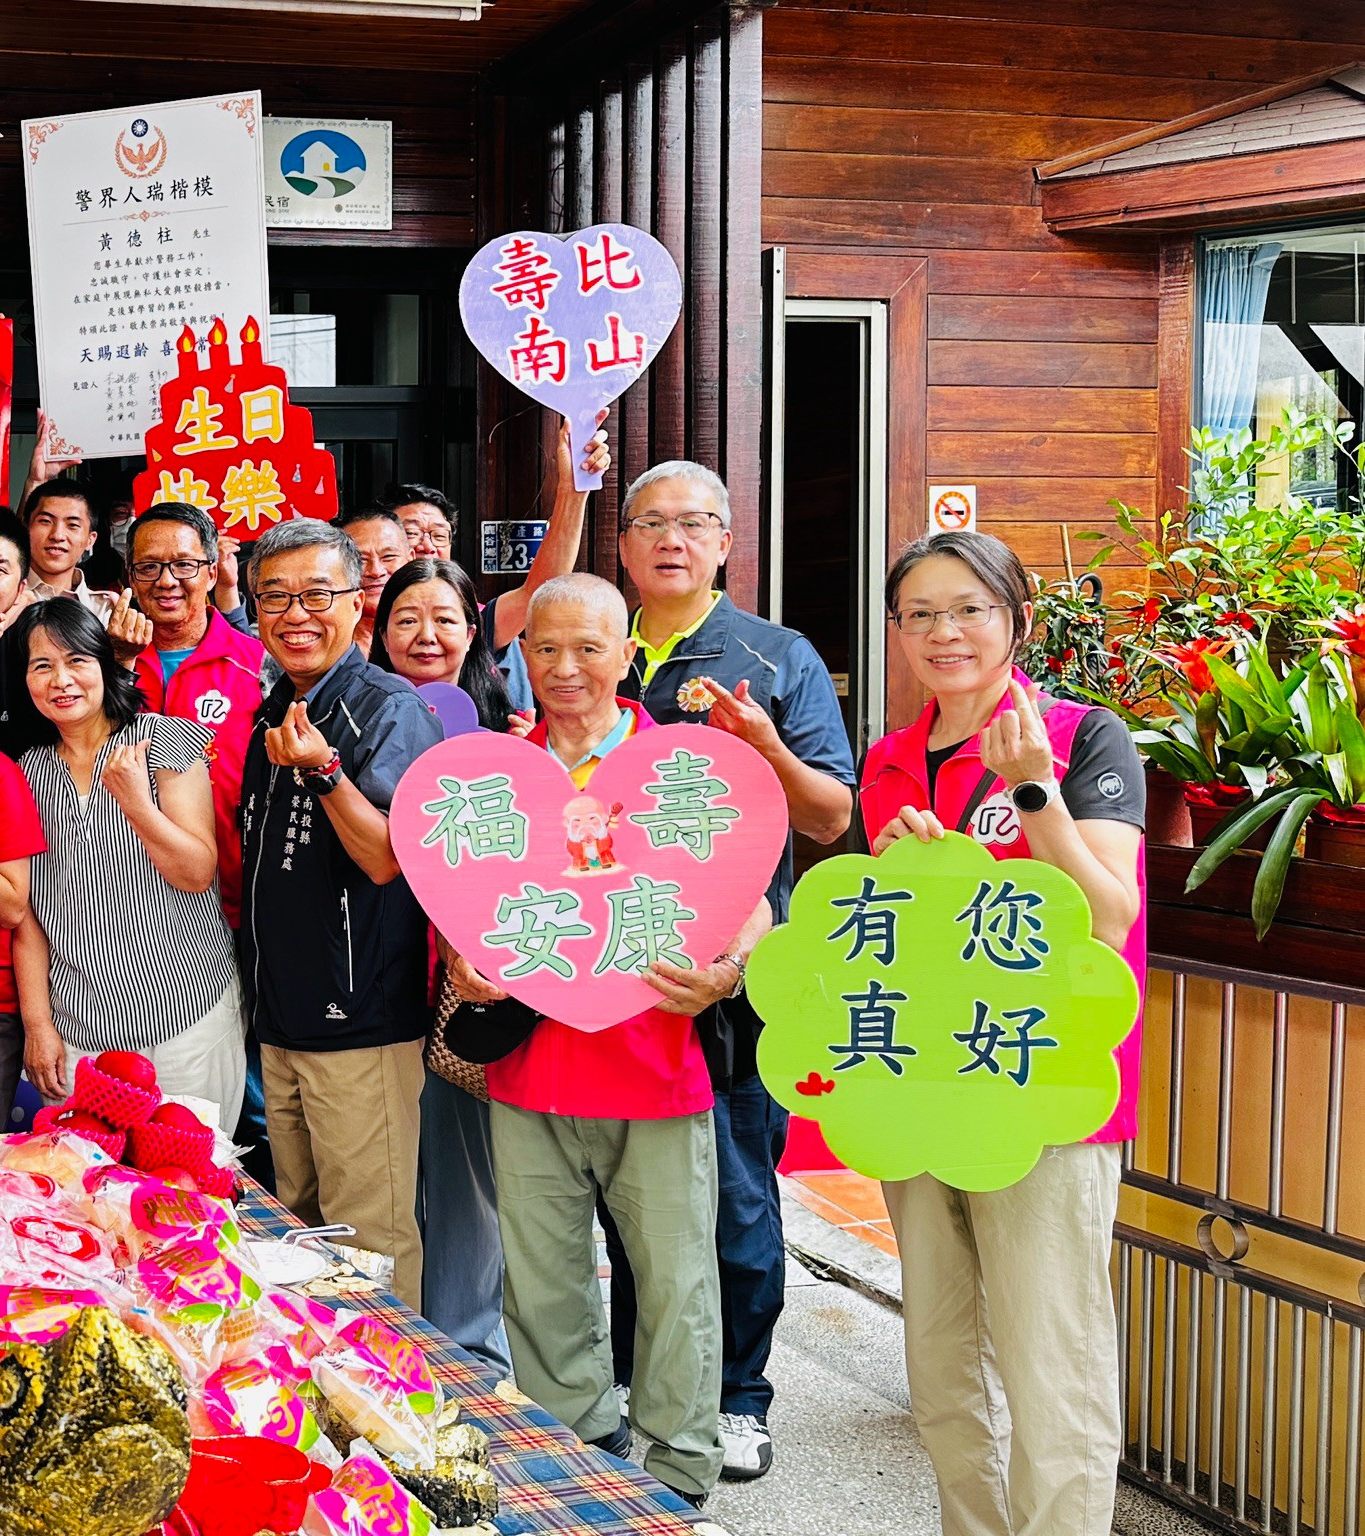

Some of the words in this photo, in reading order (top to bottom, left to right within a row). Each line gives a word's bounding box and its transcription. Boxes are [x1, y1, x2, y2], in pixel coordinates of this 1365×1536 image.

[75, 175, 214, 212] 警界人瑞楷模
[98, 227, 173, 251] 黃德柱
[192, 228, 211, 239] 先生
[493, 235, 641, 309] 壽比
[80, 342, 149, 363] 天賜遐齡
[510, 315, 643, 382] 南山
[173, 387, 284, 455] 生日
[152, 460, 286, 530] 快樂
[500, 543, 528, 569] 23
[483, 876, 696, 978] 安康
[828, 876, 1052, 970] 有您
[827, 980, 1059, 1088] 真好
